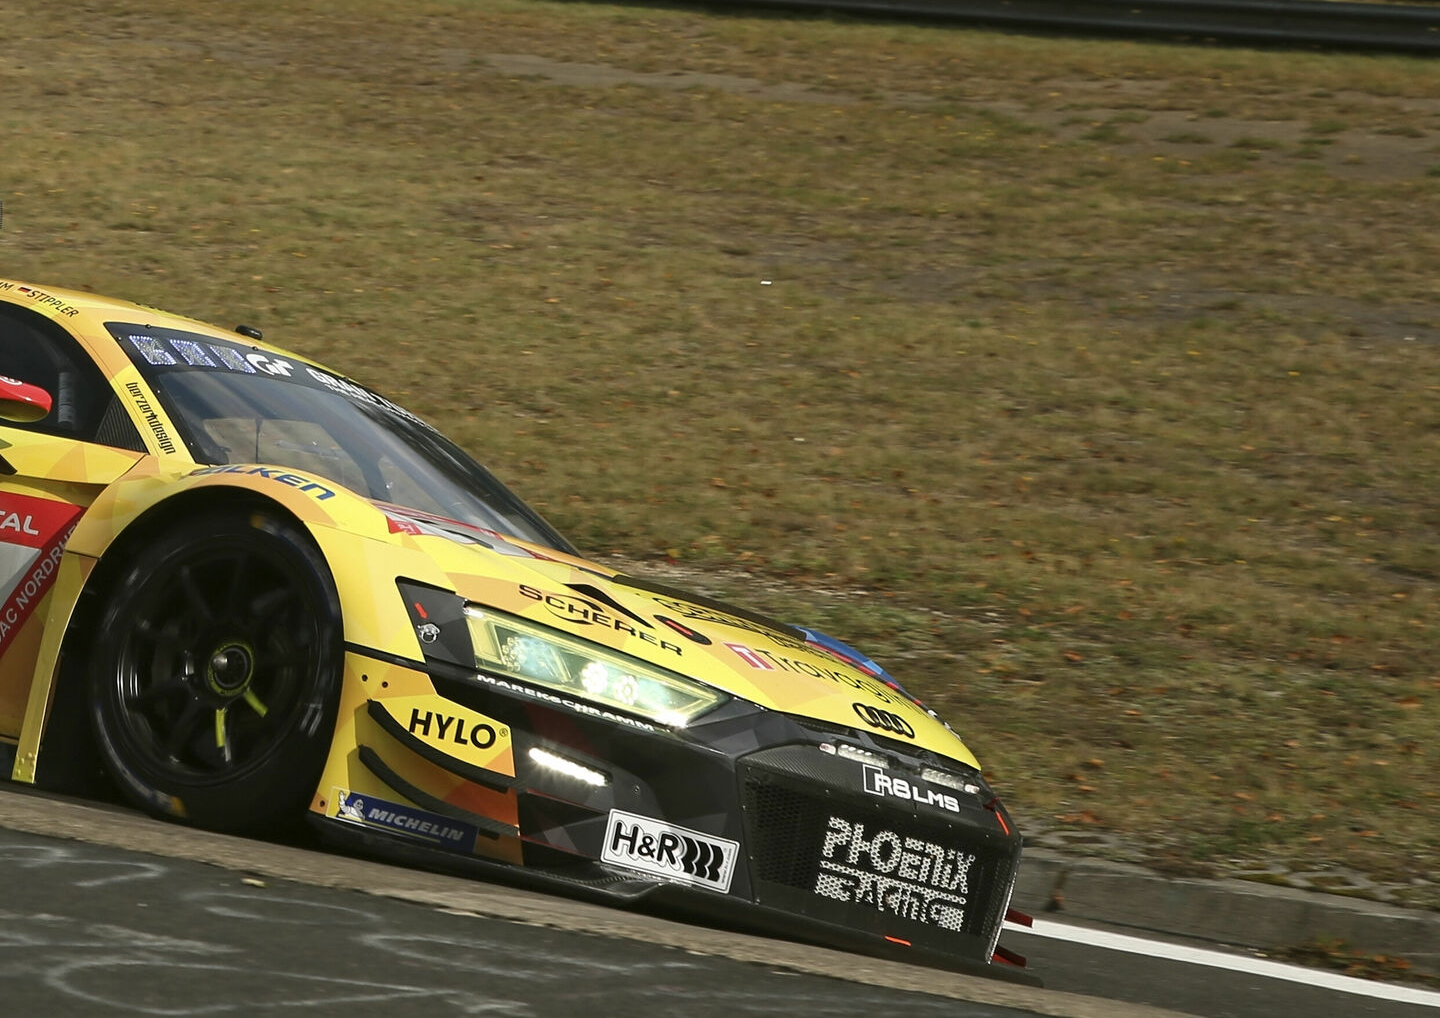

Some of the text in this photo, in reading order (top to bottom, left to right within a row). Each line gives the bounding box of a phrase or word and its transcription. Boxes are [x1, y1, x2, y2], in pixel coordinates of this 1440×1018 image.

[27, 290, 79, 318] STIPPLER
[518, 583, 683, 657] SCHERER
[477, 674, 655, 732] MAREKSCHRAMM
[874, 772, 961, 813] R8 LMS
[368, 807, 465, 842] MICHELIN
[611, 821, 680, 866] H&R
[822, 816, 976, 895] PHOENIX
